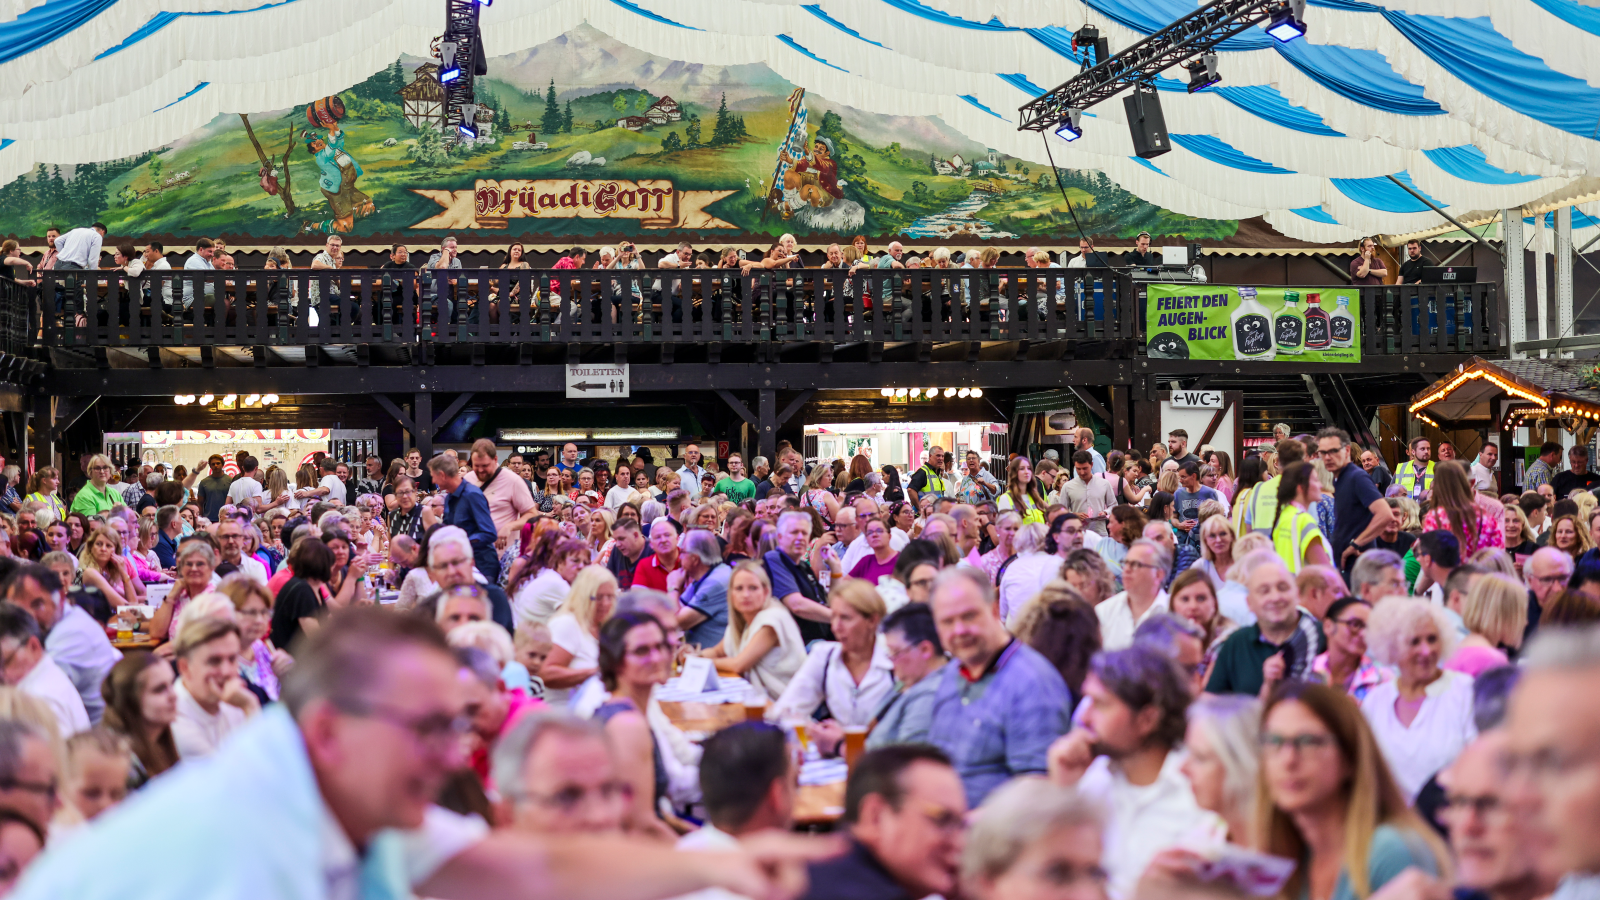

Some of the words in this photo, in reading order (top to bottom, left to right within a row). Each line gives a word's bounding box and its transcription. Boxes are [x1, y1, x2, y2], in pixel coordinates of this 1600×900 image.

[1157, 295, 1200, 311] FEIERT
[1201, 293, 1228, 308] DEN
[1157, 311, 1208, 327] AUGEN-
[1188, 325, 1227, 341] BLICK
[569, 368, 625, 377] TOILETTEN
[1184, 392, 1211, 406] WC
